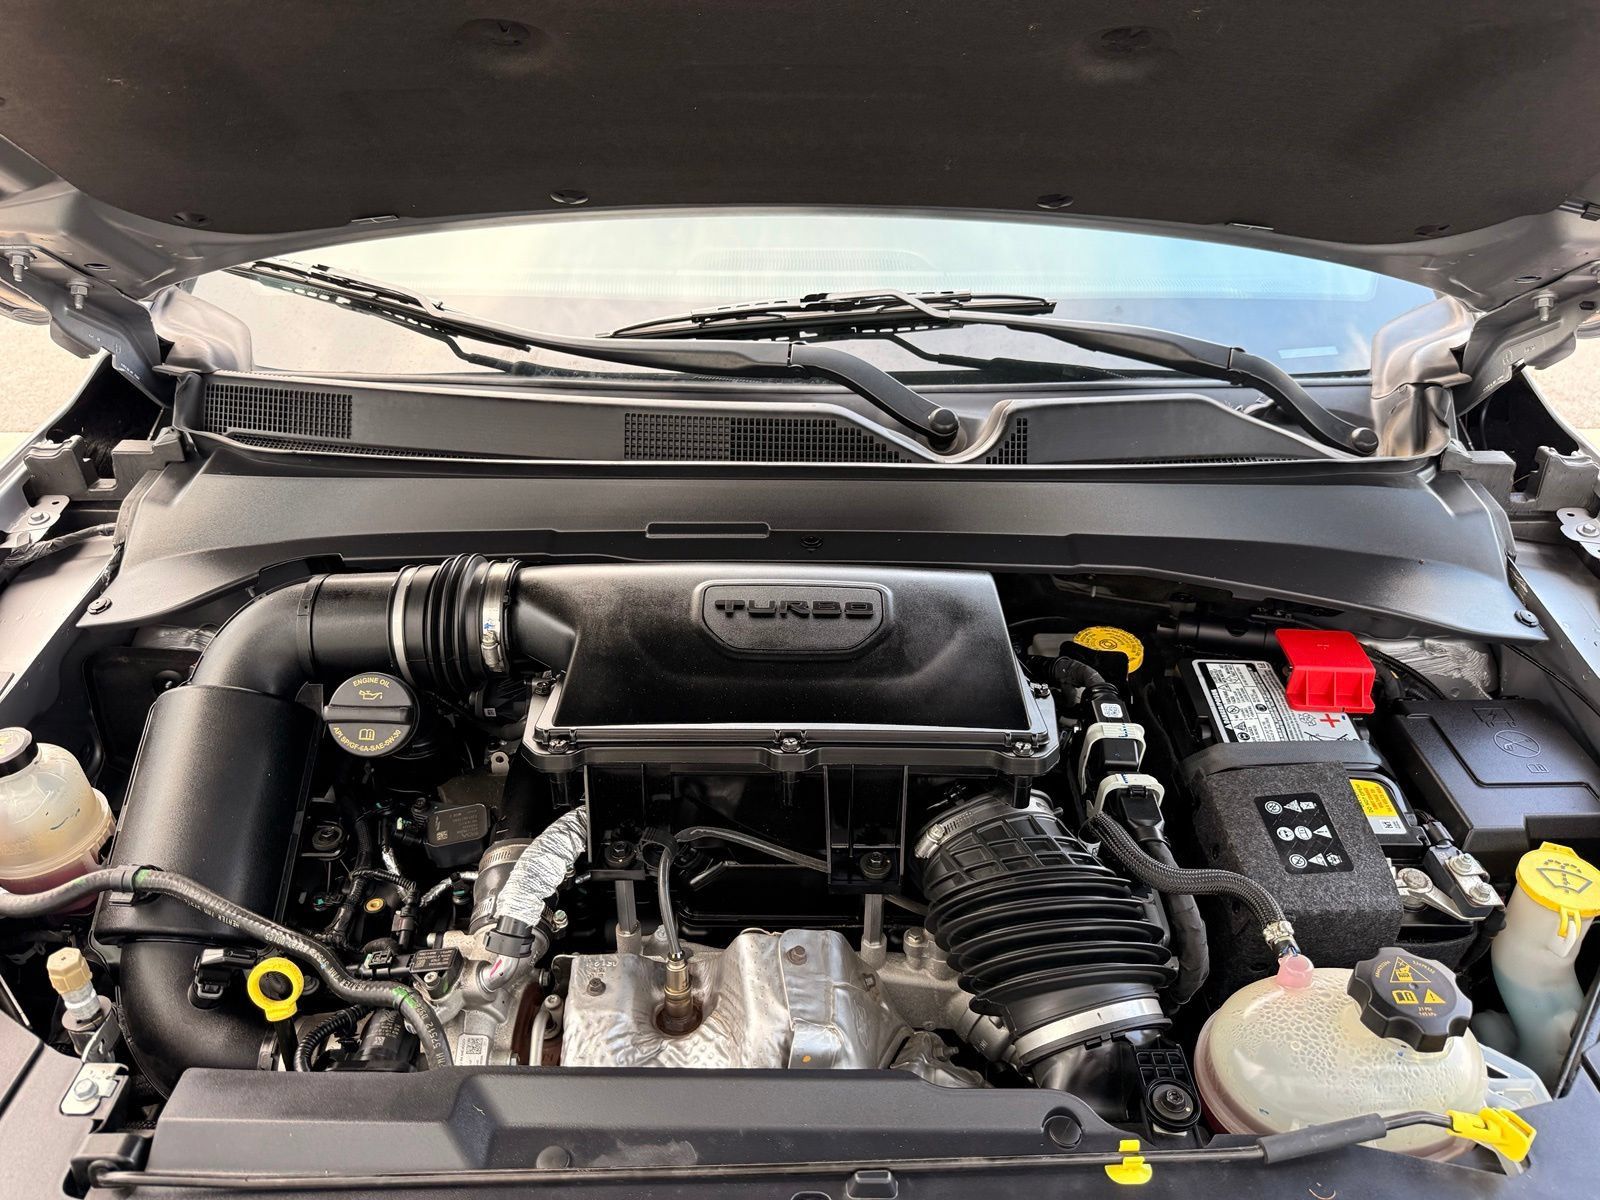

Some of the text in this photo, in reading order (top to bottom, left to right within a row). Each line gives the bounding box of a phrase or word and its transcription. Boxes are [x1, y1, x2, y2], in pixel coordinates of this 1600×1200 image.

[714, 599, 873, 619] TURBO
[352, 677, 391, 688] ENGINE OIL
[333, 726, 343, 739] API
